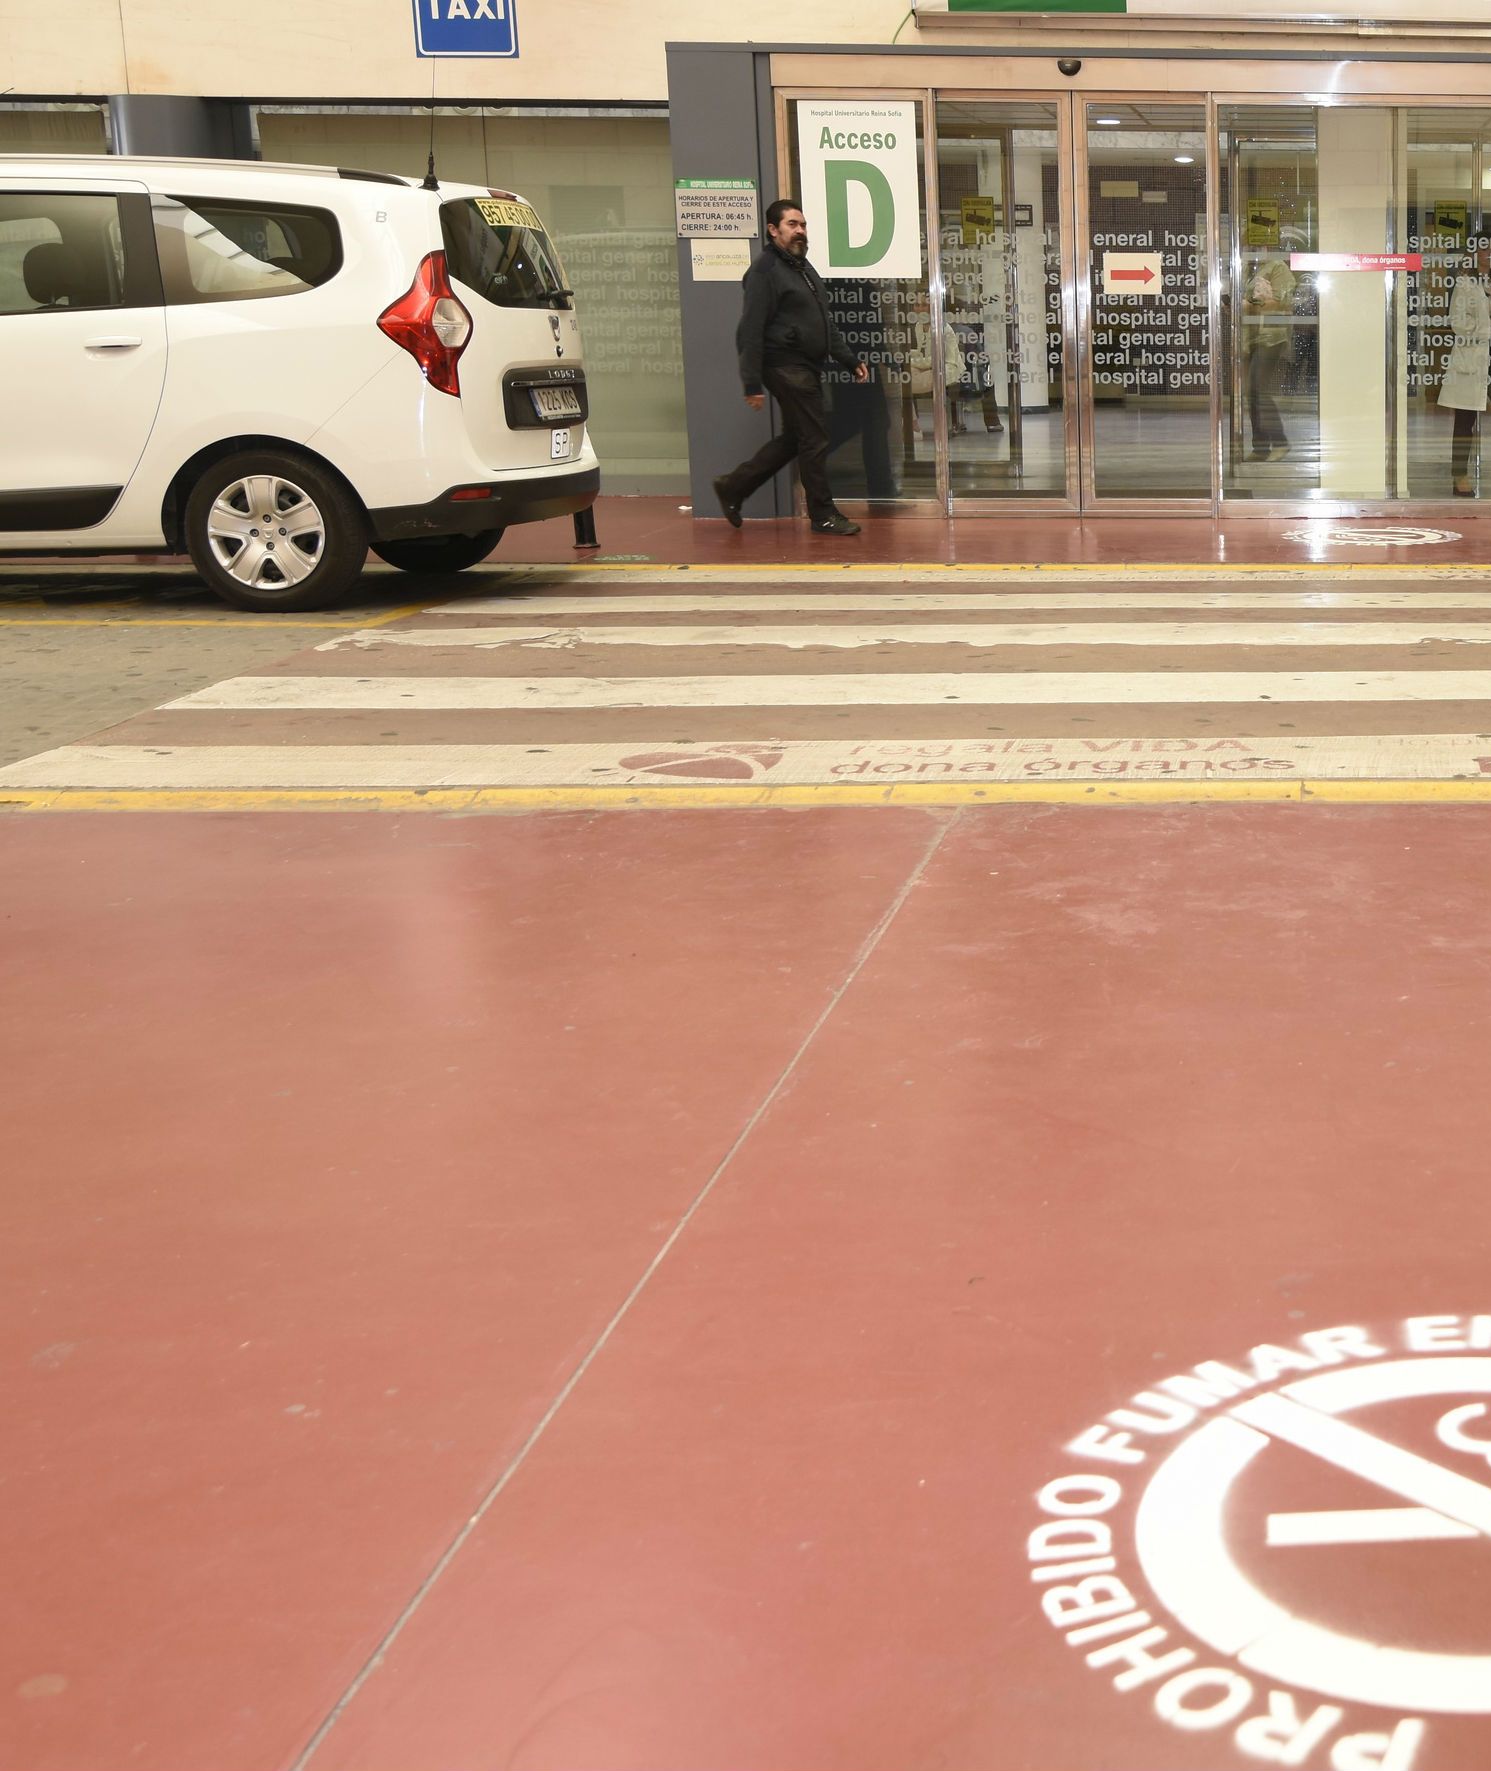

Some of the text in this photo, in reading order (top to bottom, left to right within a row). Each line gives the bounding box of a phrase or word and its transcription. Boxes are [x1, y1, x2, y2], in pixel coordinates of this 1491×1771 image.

[811, 110, 833, 118] Hospital
[819, 126, 897, 150] Acceso
[824, 160, 896, 267] D
[602, 249, 669, 266] general
[571, 267, 635, 284] general
[1096, 309, 1172, 328] hospital
[1119, 330, 1190, 348] general
[1142, 349, 1210, 369] hospita
[538, 390, 561, 411] 1225
[555, 432, 568, 454] SP
[849, 739, 1254, 758] regala VIDA
[831, 757, 1296, 775] dona órganos
[1065, 1322, 1388, 1466] FUMAR
[1024, 1470, 1428, 1771] PROHIBIDO
